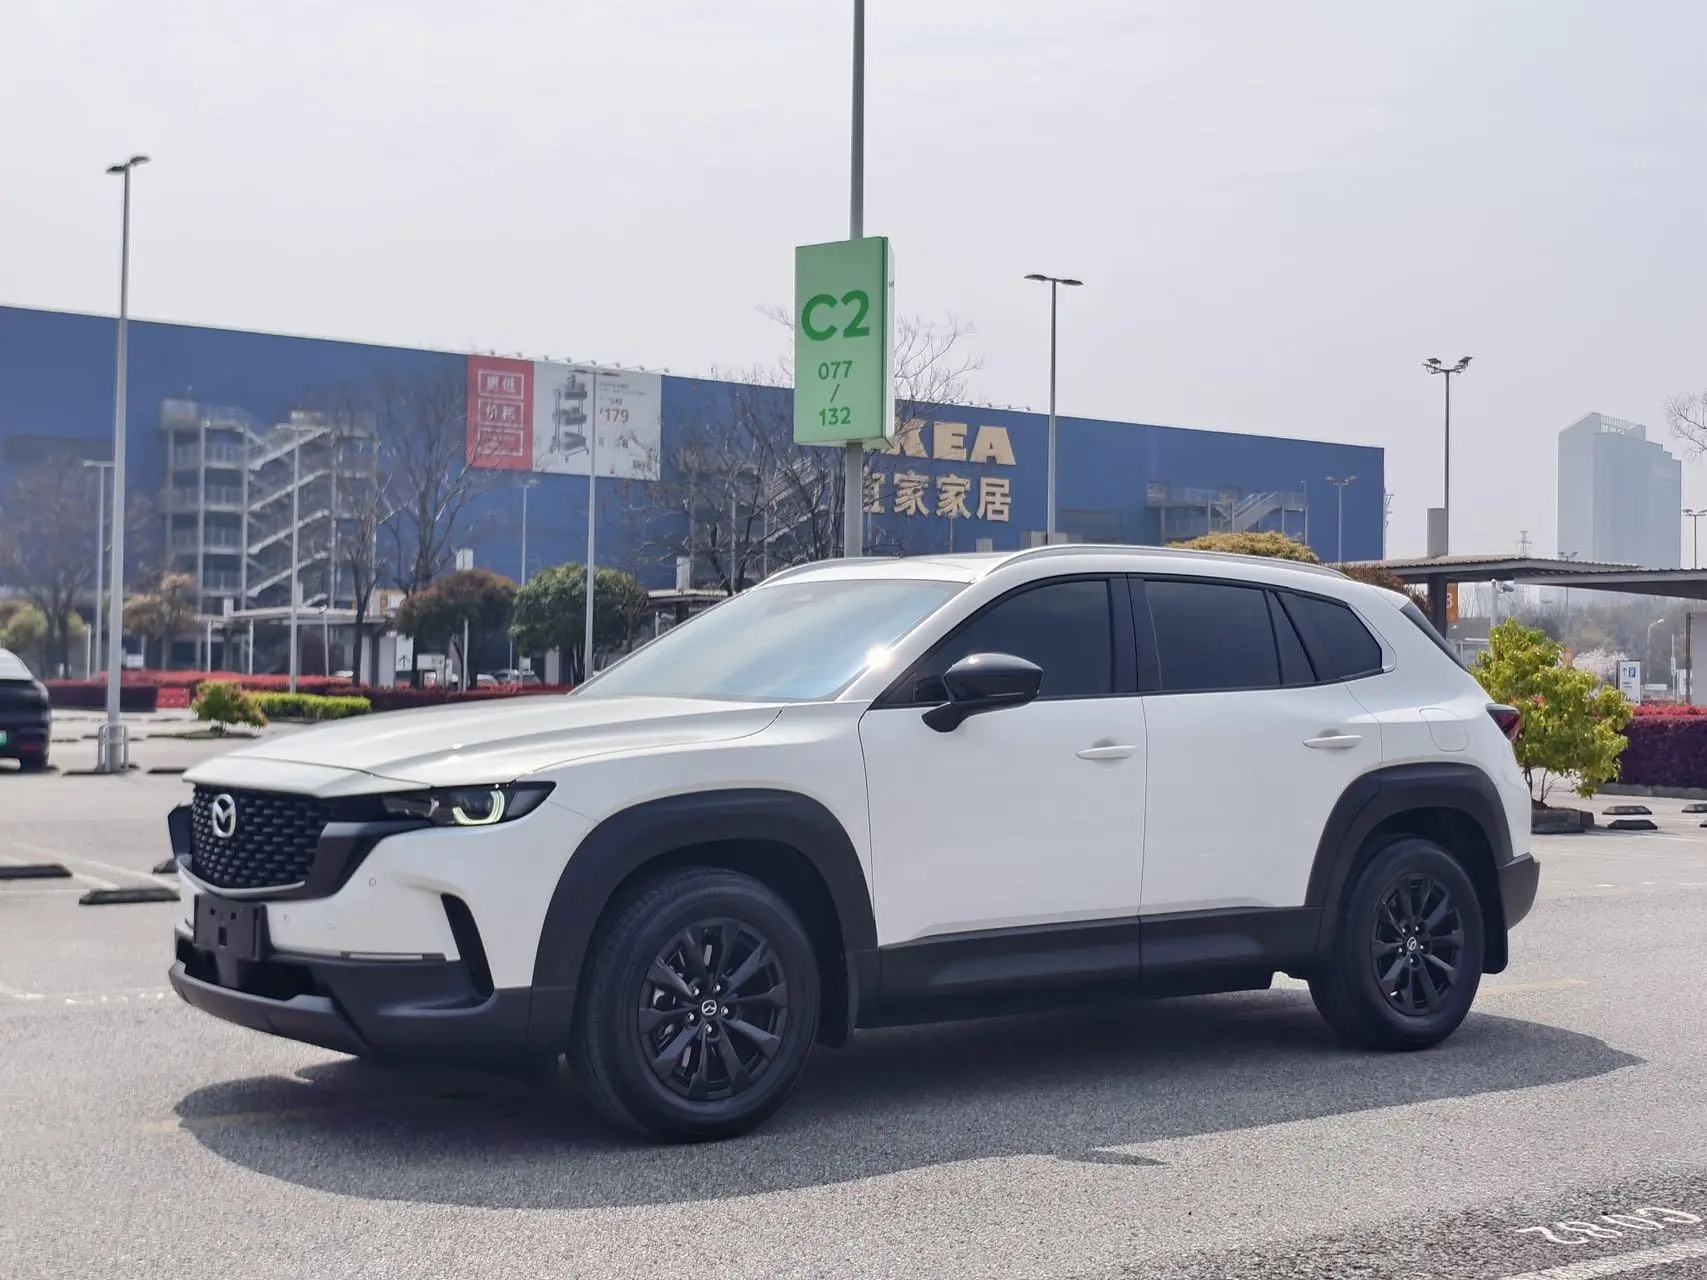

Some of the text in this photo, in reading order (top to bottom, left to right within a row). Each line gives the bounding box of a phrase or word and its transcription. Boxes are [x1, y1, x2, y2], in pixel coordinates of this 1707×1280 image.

[801, 290, 870, 342] C2
[818, 360, 853, 380] 077
[819, 406, 851, 427] 132
[880, 418, 1016, 465] KEA
